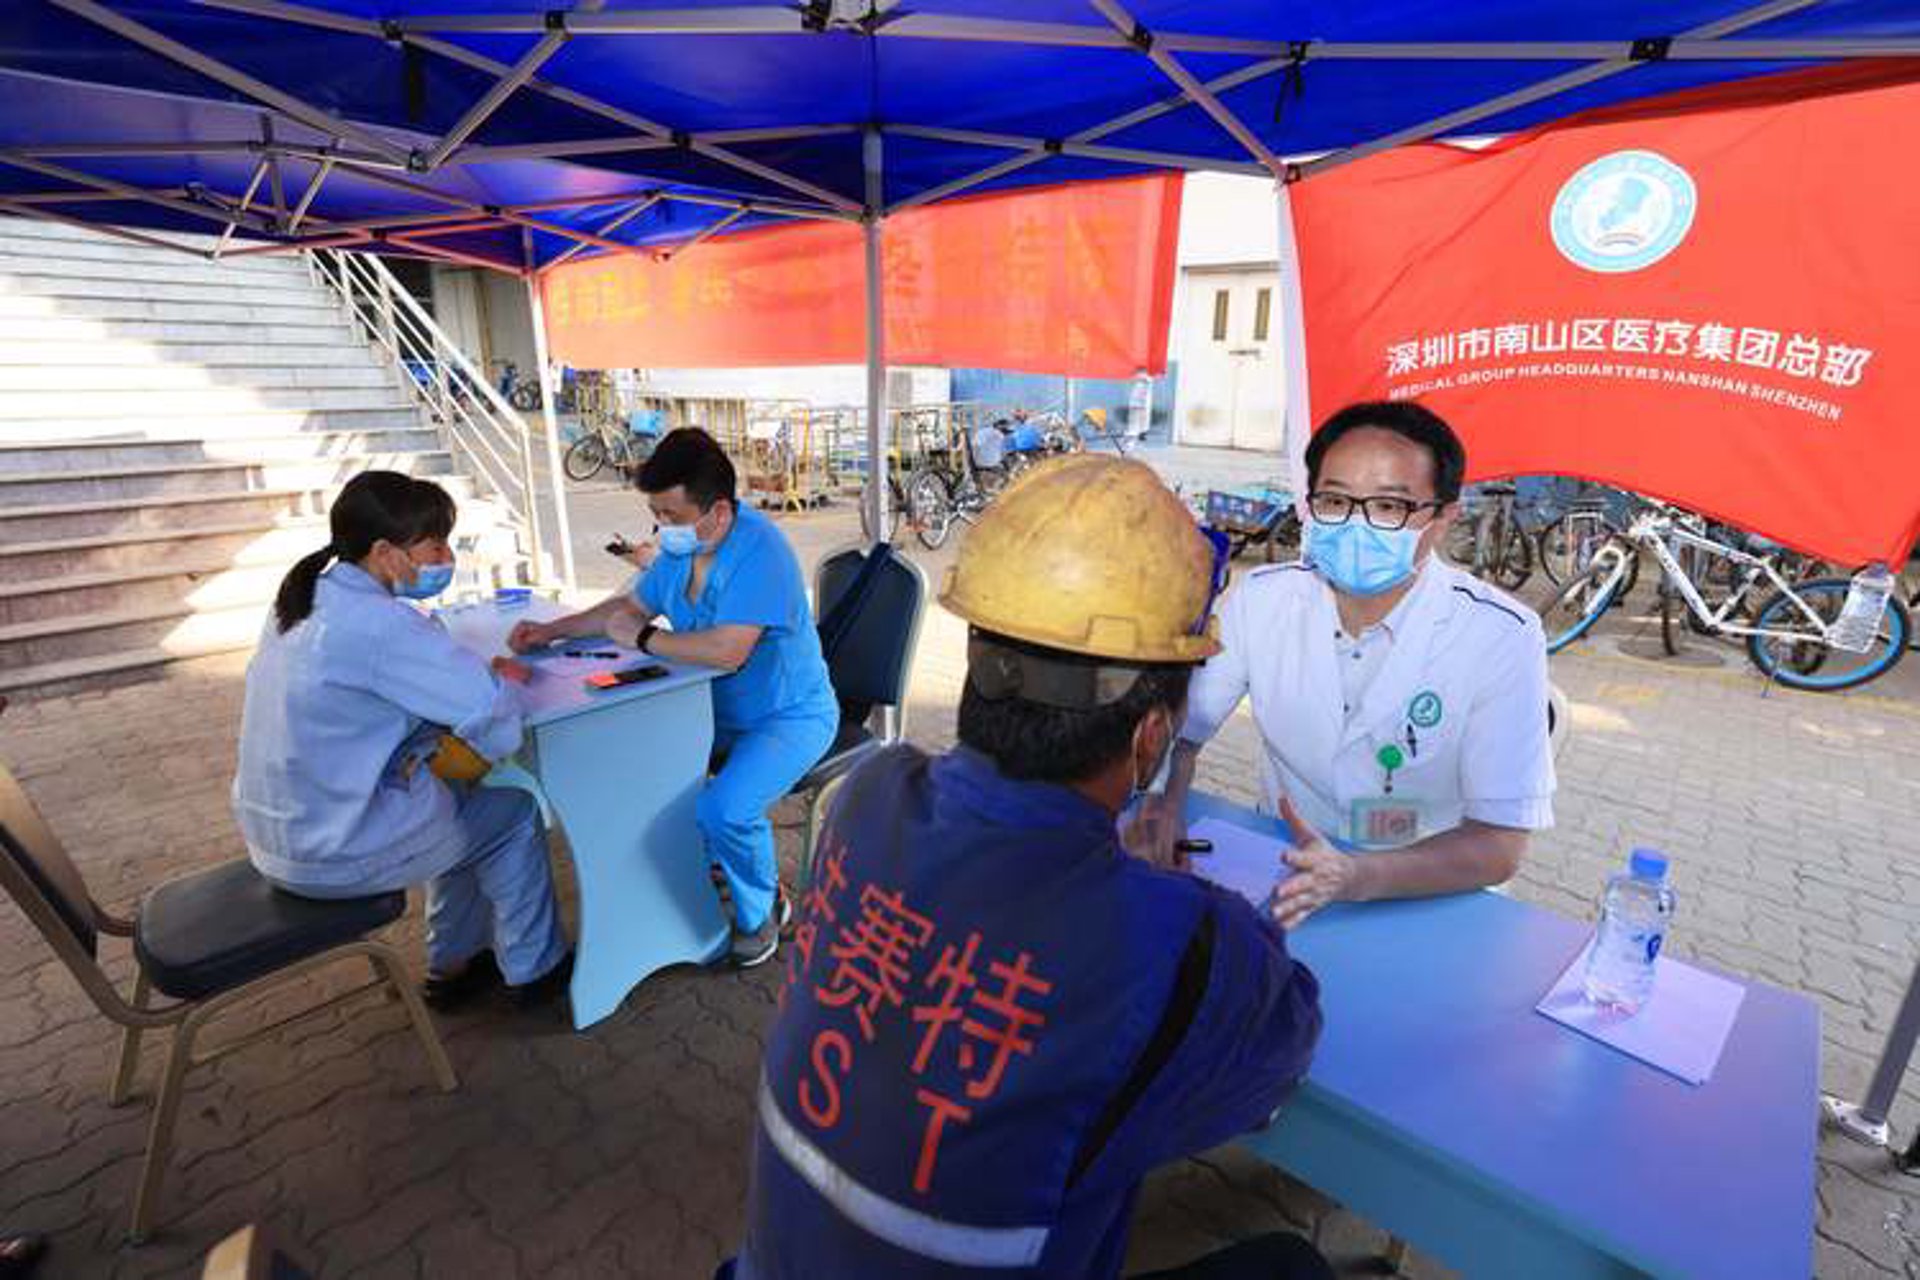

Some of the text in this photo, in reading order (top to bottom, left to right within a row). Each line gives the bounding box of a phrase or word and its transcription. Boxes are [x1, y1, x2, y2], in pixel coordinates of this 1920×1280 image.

[1386, 318, 1873, 387] 深圳市南山区医疗集团总部
[1388, 362, 1843, 421] MEDICAL GROUP HEADQUARTERS NANSHAN SHENZHEN
